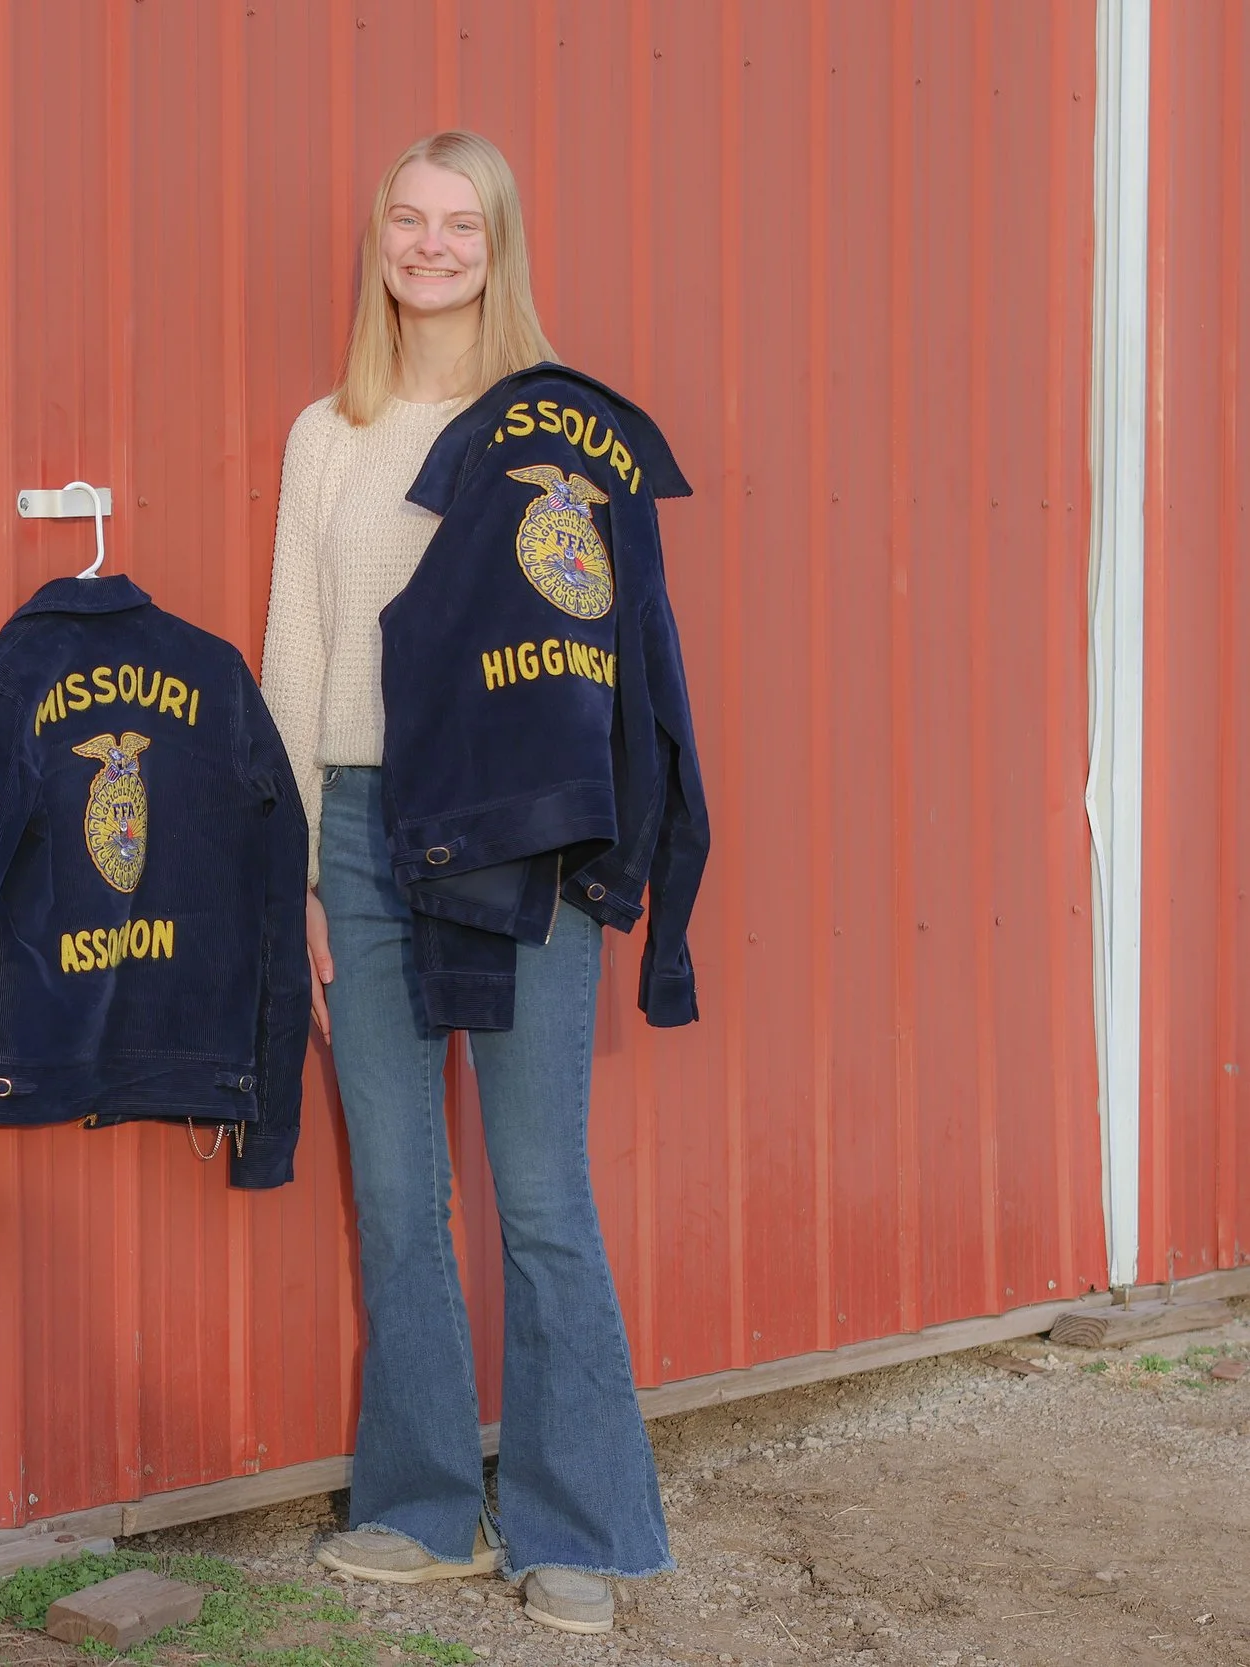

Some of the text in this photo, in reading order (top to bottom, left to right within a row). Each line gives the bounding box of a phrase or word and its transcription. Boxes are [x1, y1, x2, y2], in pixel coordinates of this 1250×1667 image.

[487, 400, 642, 495] SSOURI
[555, 529, 589, 555] FFA
[546, 571, 600, 600] EDUCATION
[481, 639, 616, 691] HIGGINSV
[34, 664, 200, 737] MISSOURI
[112, 801, 136, 821] FFA
